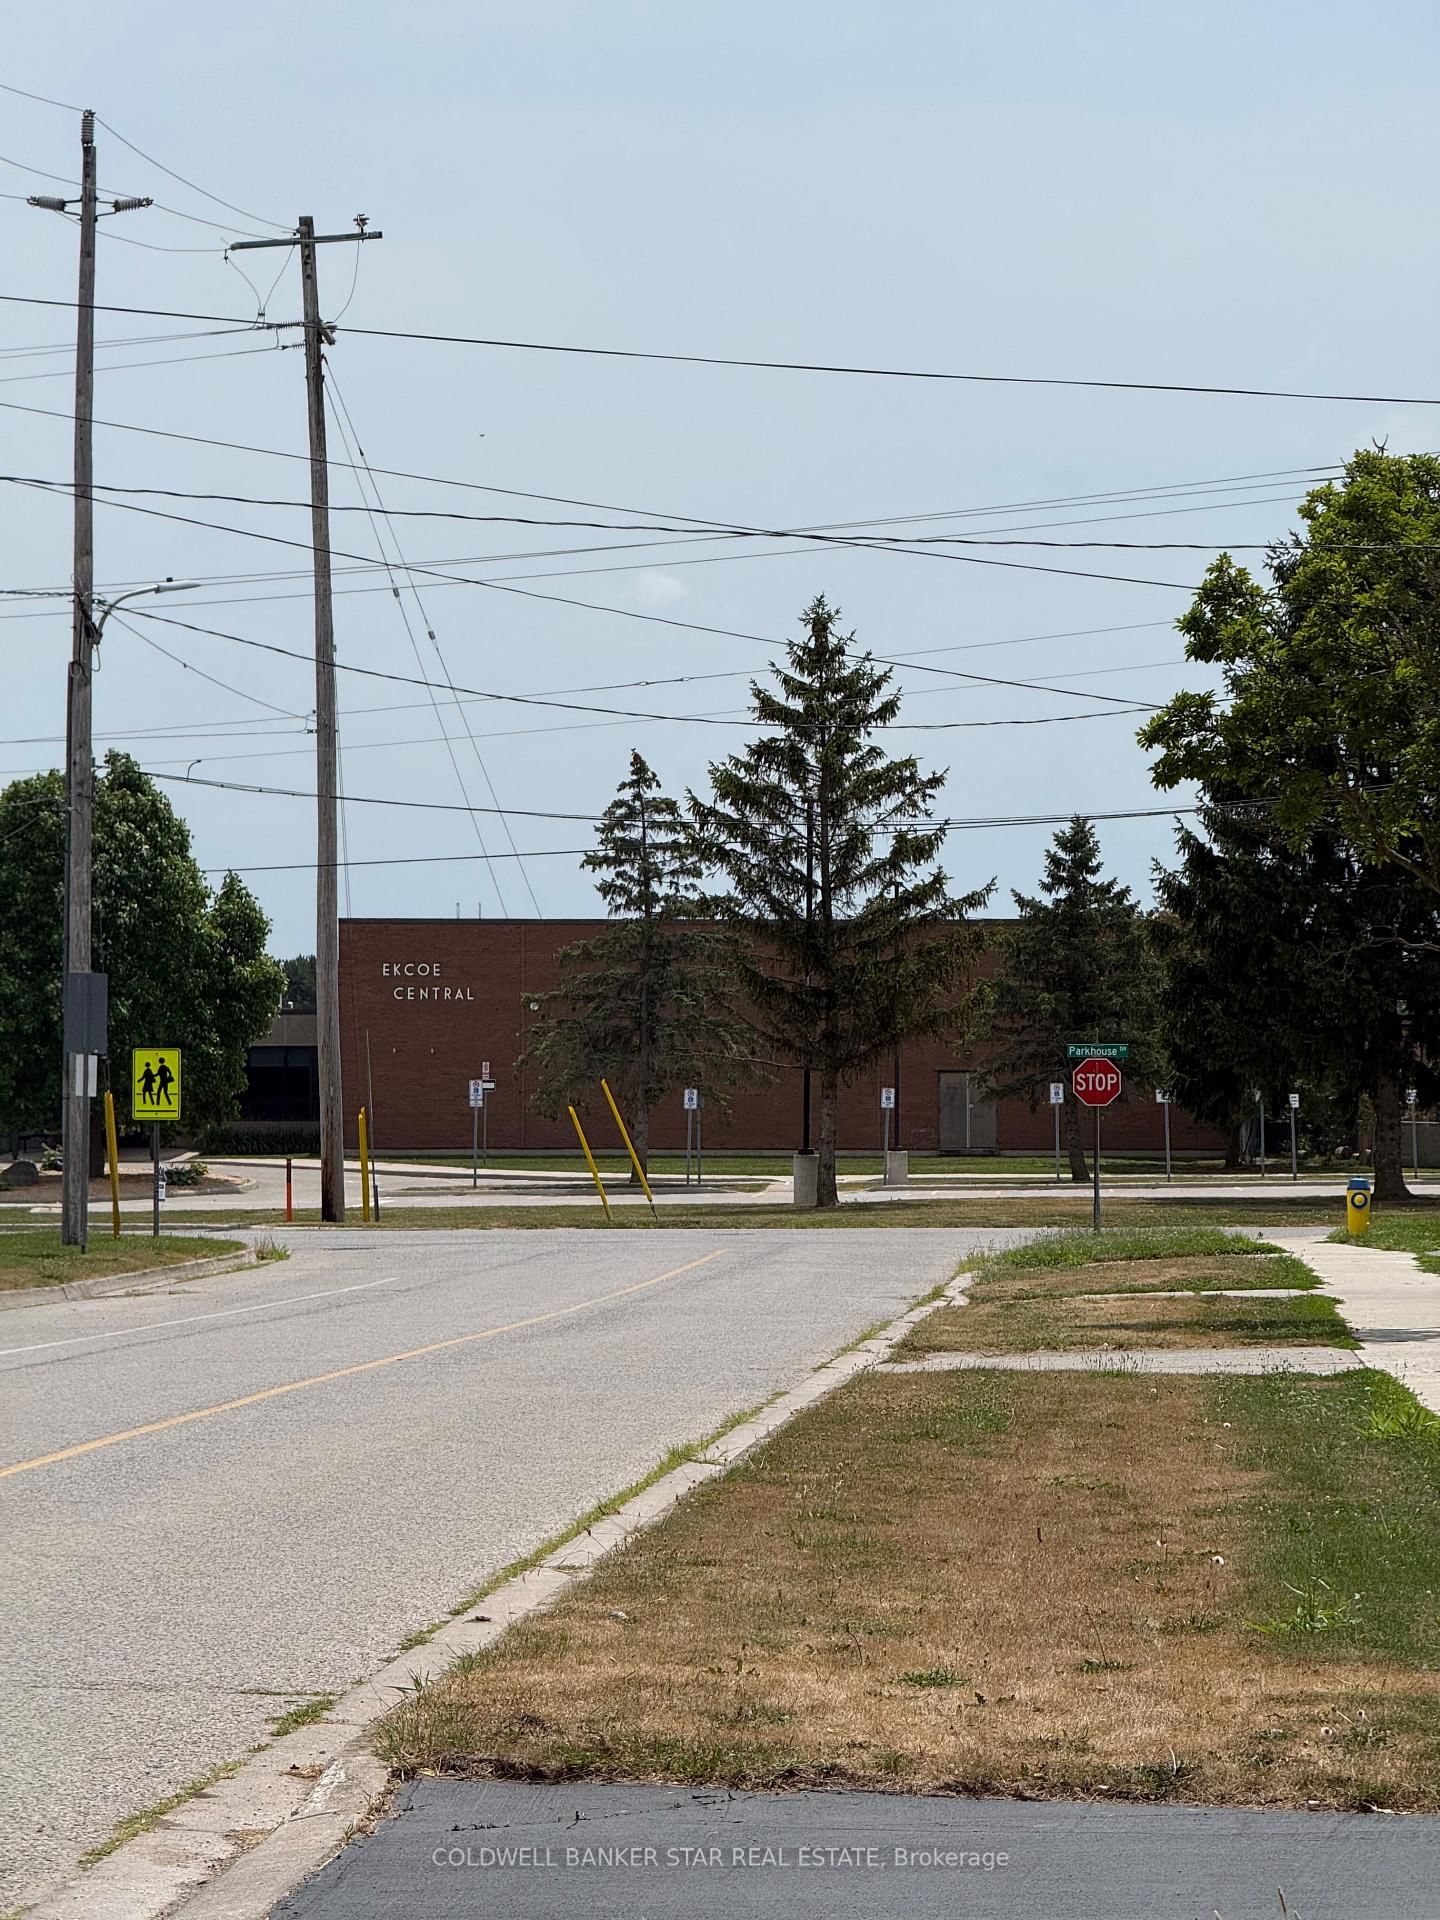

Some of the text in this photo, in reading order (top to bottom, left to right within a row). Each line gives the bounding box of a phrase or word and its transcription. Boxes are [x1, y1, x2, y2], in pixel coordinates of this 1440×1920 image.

[382, 963, 441, 976] EKCOE
[393, 987, 475, 1000] CENTRAL
[1069, 1046, 1118, 1056] Parkhouse
[1076, 1073, 1117, 1091] STOP
